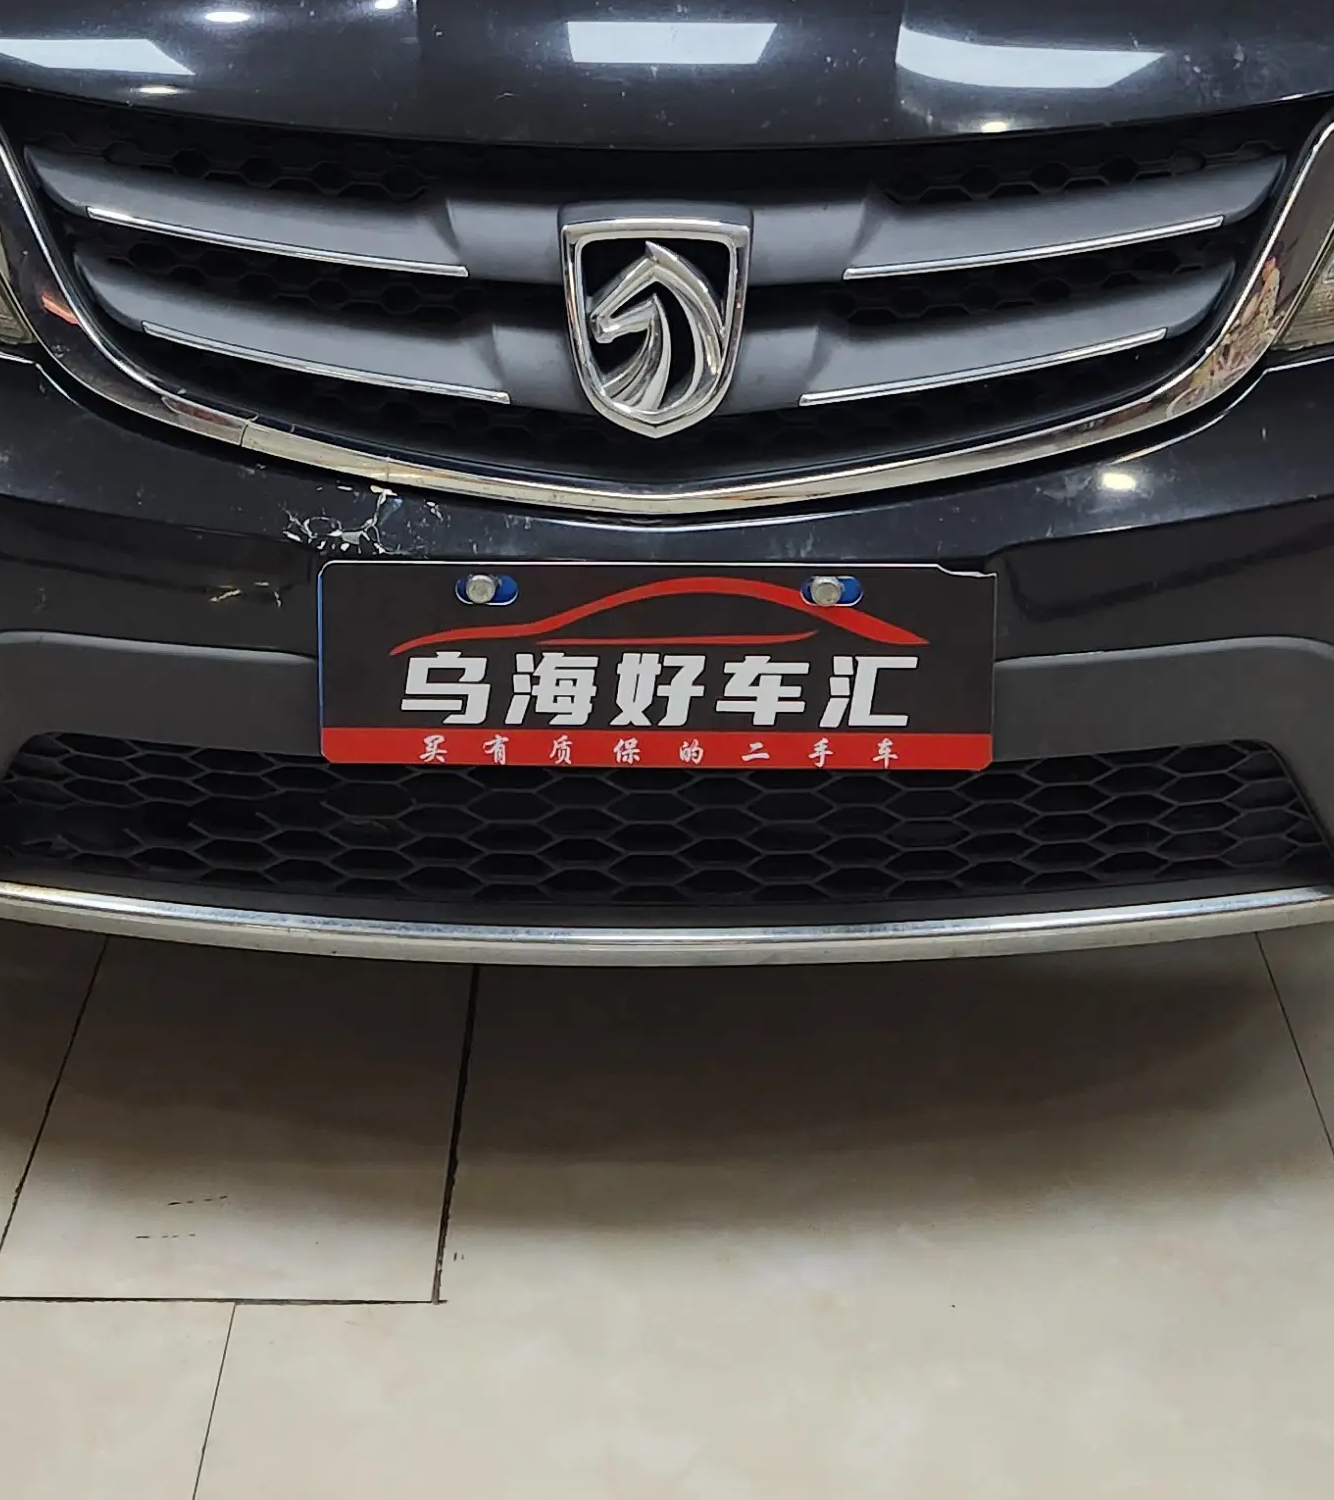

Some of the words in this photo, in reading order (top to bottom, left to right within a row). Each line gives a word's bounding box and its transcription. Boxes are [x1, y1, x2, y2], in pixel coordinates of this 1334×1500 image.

[399, 651, 919, 728] 乌海好车汇
[418, 734, 899, 769] 买有质保的二手车
